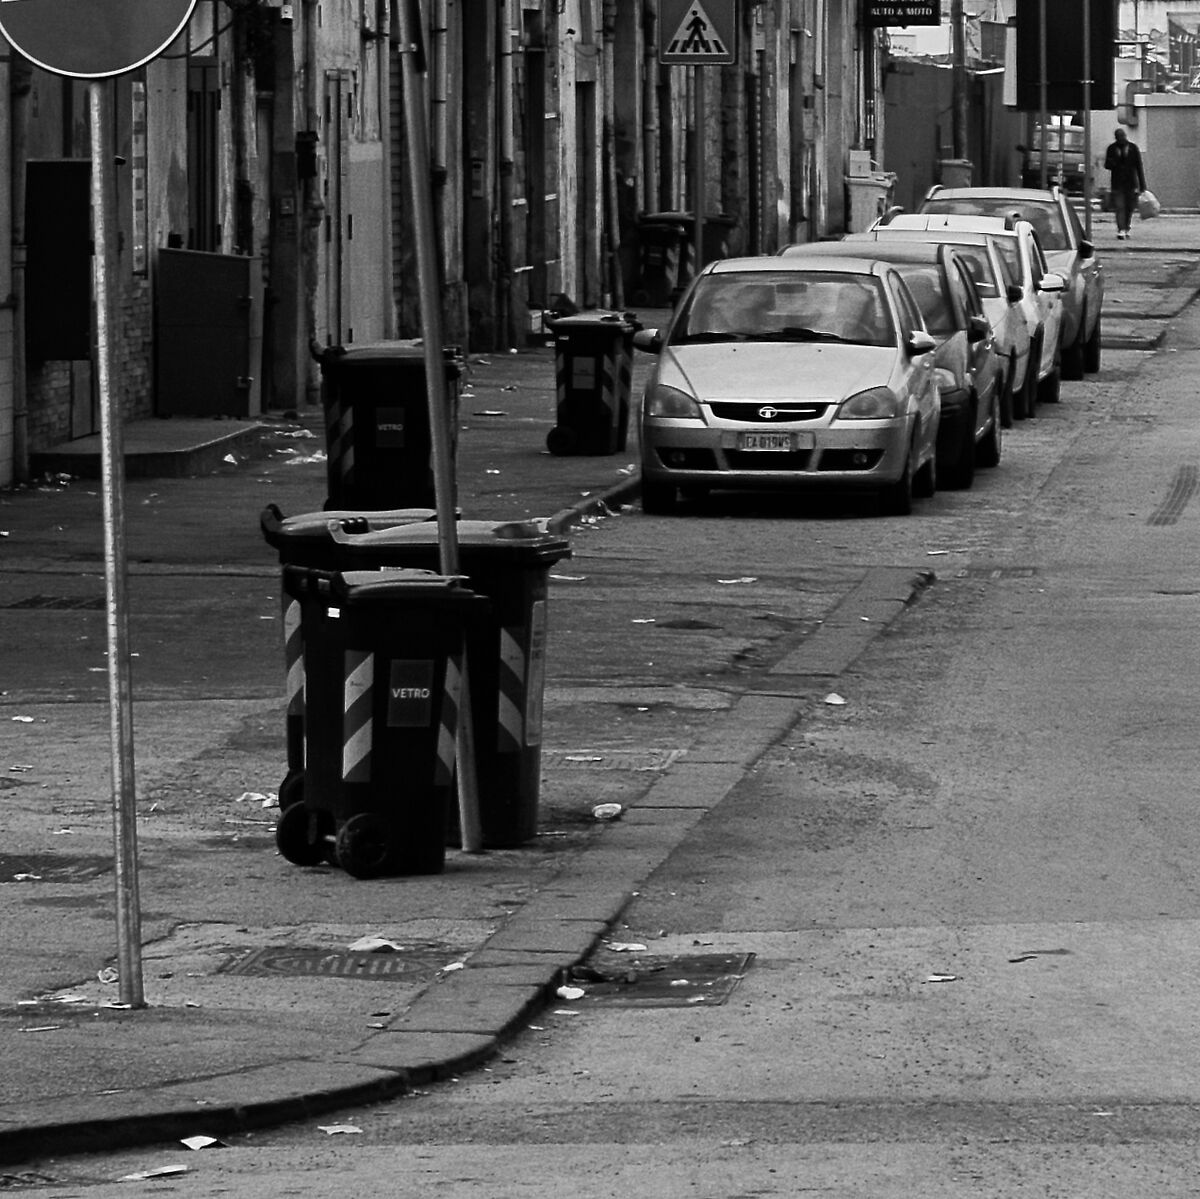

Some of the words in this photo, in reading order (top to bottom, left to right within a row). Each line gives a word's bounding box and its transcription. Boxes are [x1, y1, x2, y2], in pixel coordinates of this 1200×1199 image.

[871, 7, 895, 15] AUTO
[897, 7, 903, 15] &
[906, 7, 933, 15] MOTO
[392, 688, 430, 698] VETRO
